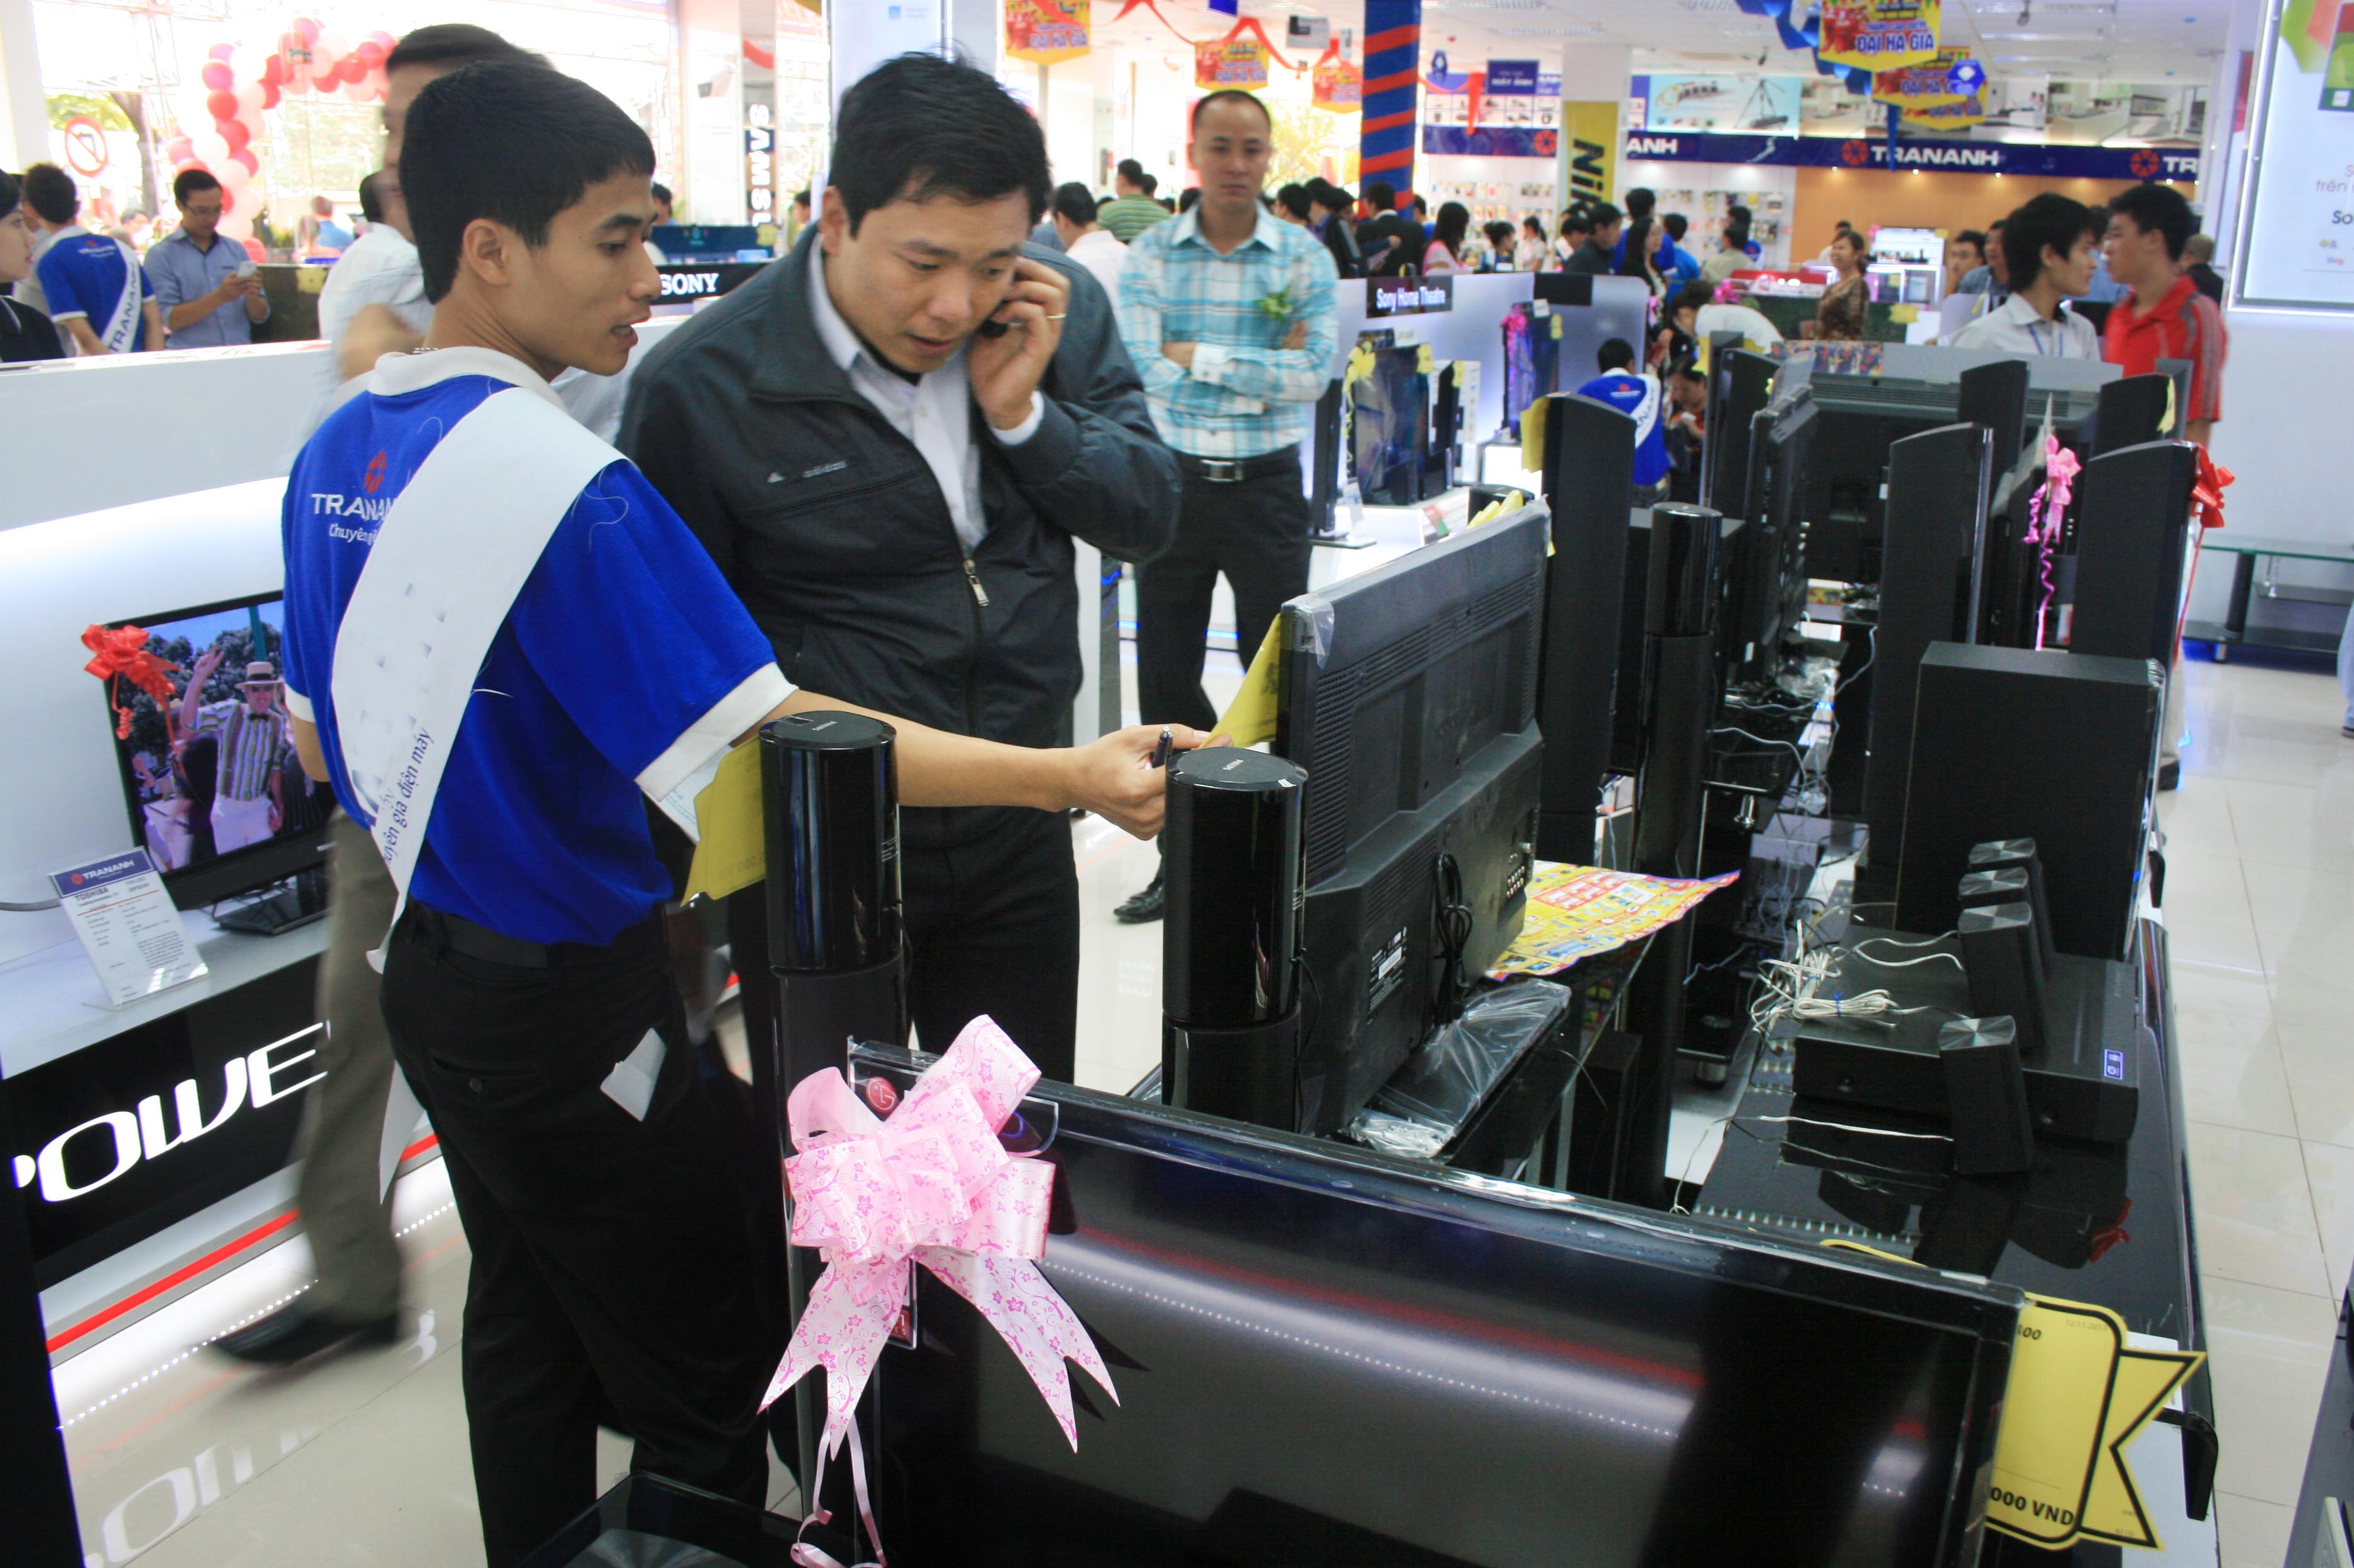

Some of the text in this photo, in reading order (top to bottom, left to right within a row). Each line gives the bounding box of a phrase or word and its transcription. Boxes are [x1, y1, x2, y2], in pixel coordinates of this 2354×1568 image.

[1870, 145, 2000, 167] TRANANH
[2332, 209, 2354, 225] So
[659, 272, 720, 296] SONY
[411, 727, 434, 764] máy
[397, 765, 419, 799] điện
[392, 801, 407, 828] gia
[82, 859, 135, 880] TRANANH
[74, 886, 110, 902] TOSHIBA
[11, 1019, 332, 1202] OWE
[2032, 1499, 2075, 1526] VND
